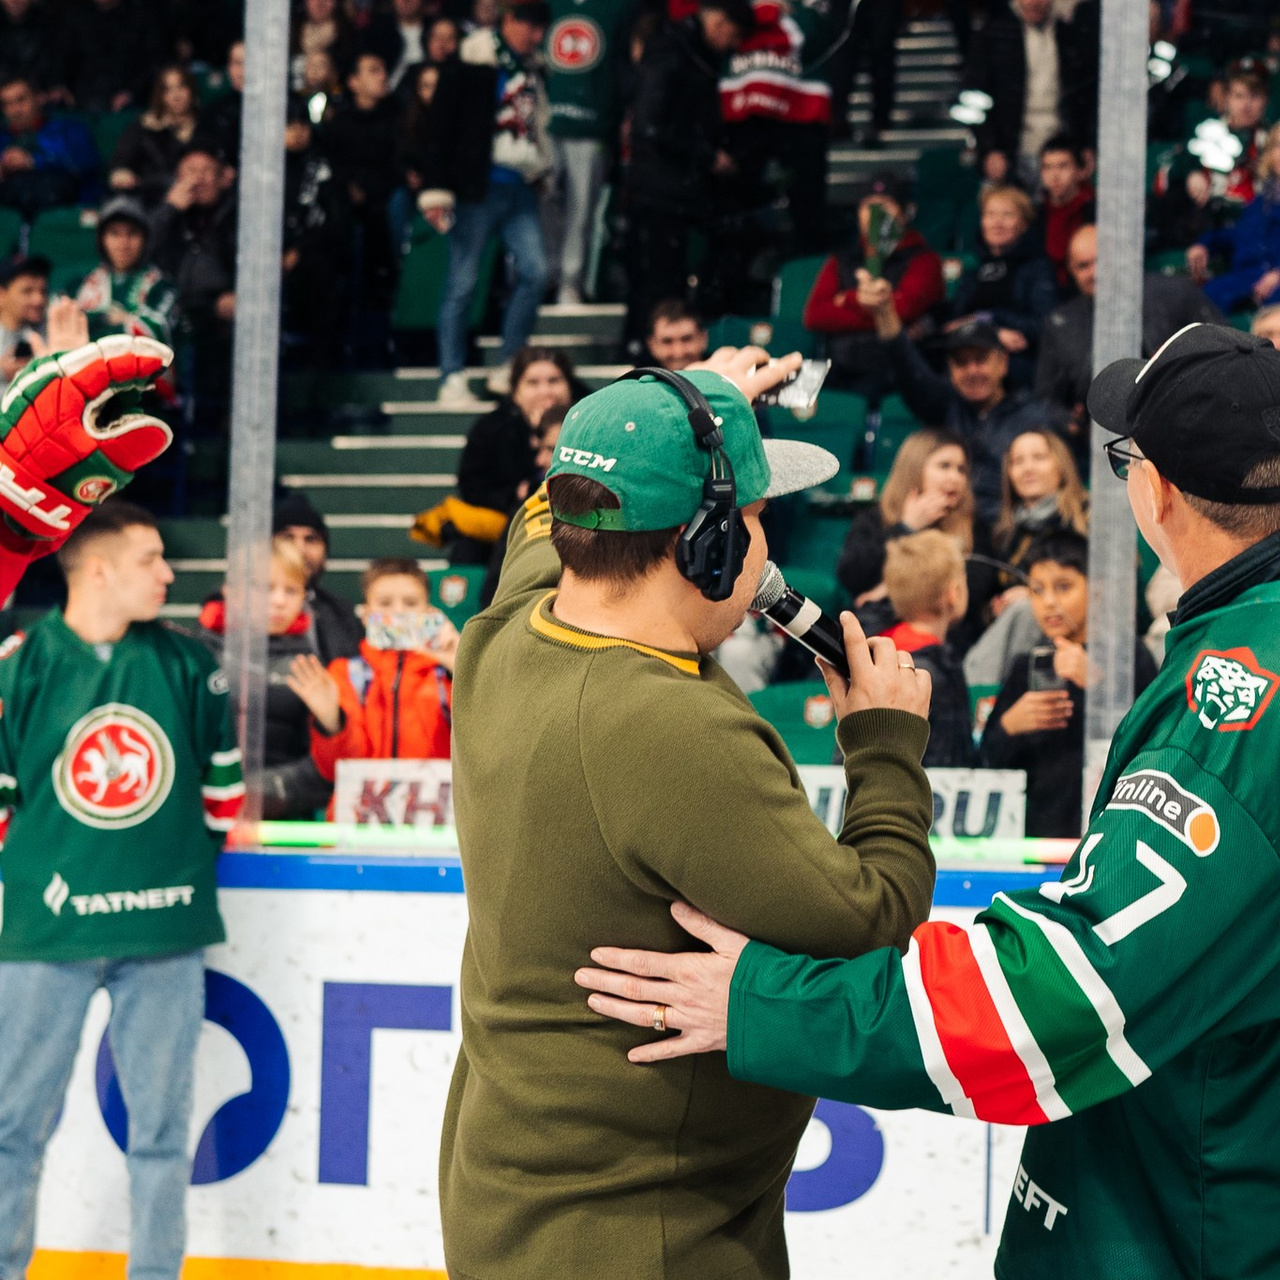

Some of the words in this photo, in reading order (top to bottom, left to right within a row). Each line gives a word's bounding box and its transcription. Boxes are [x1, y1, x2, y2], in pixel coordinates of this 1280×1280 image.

[559, 446, 618, 472] CCM
[1112, 778, 1182, 821] inline
[70, 885, 195, 916] TATNEFT
